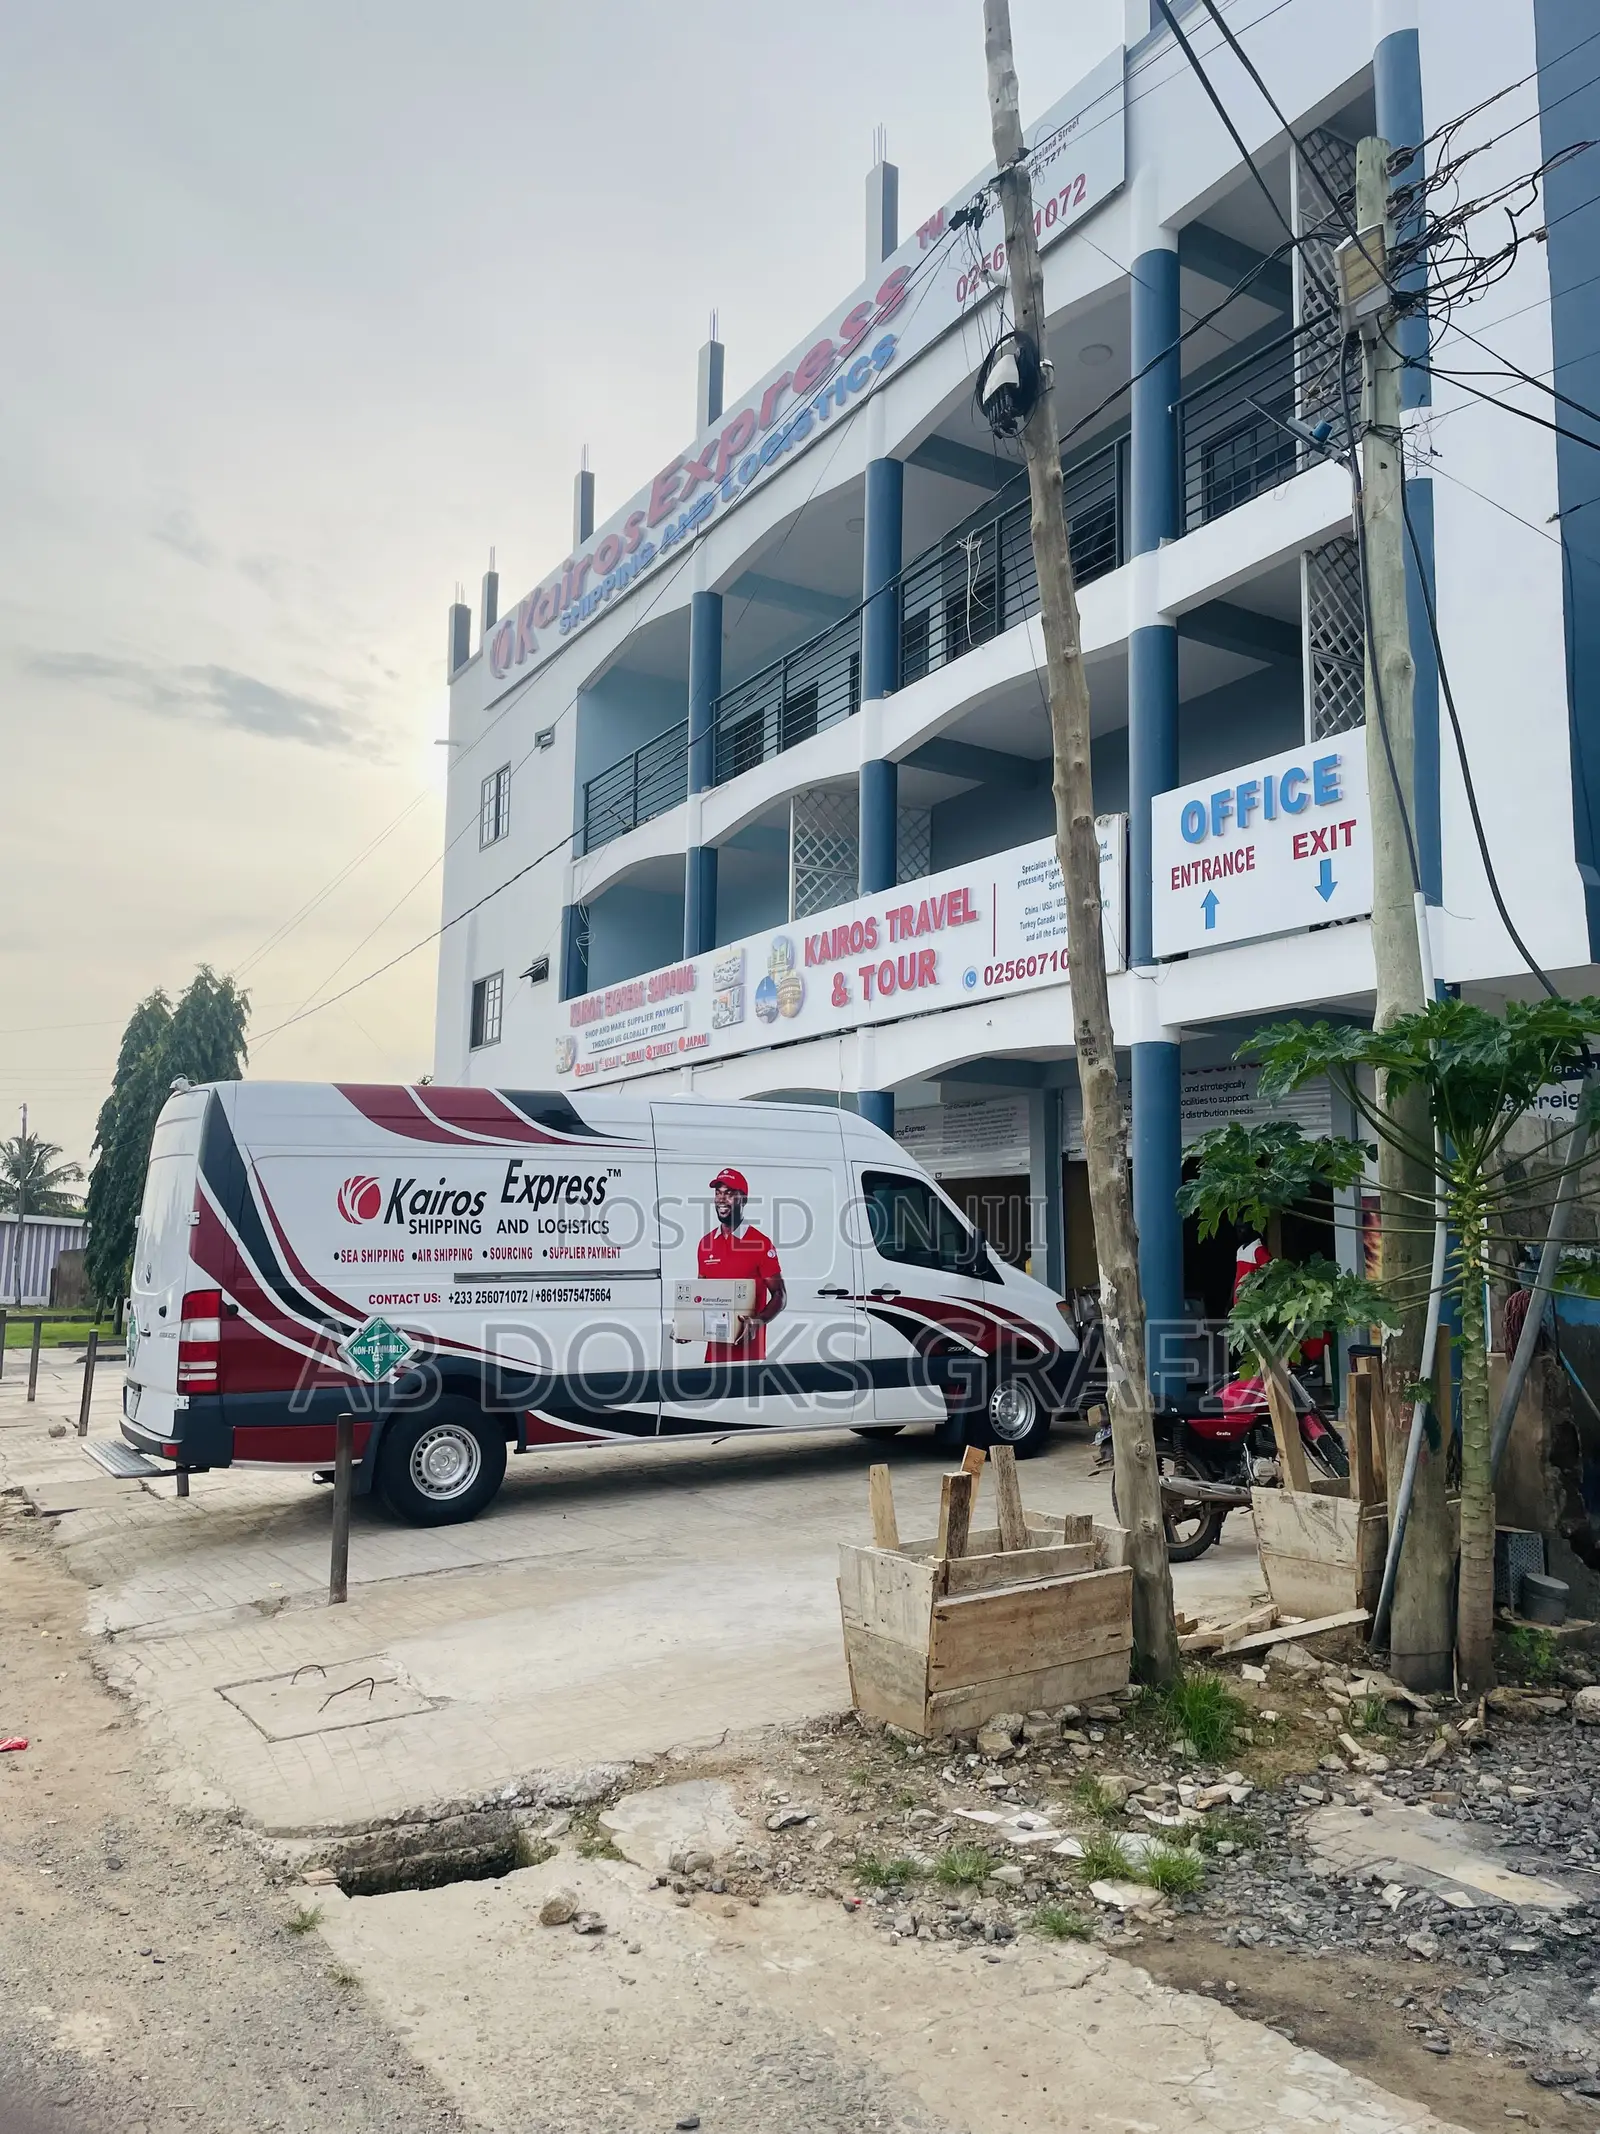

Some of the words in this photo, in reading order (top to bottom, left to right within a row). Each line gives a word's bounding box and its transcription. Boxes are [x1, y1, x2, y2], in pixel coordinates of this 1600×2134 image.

[1058, 117, 1080, 141] Street
[956, 173, 1086, 303] 02561072
[515, 510, 645, 665] Kairos
[647, 265, 911, 528] Express
[559, 541, 656, 636] SHIPPING
[660, 491, 717, 555] AND
[720, 333, 898, 503] LOGISTICS
[1180, 753, 1343, 845] OFFICE
[1022, 860, 1047, 875] Specialize
[1048, 857, 1054, 866] in
[1170, 845, 1255, 891] ENTRANCE
[1293, 819, 1358, 861] EXIT
[1017, 873, 1045, 889] processing
[1045, 867, 1060, 880] Flight
[1048, 880, 1065, 891] Servic
[1025, 904, 1039, 915] China
[805, 917, 879, 967] KAIROS
[886, 887, 978, 943] TRAVEL
[1020, 919, 1036, 930] Turkey
[1037, 915, 1055, 926] Canada
[1026, 934, 1035, 942] and
[1043, 929, 1051, 938] the
[1052, 926, 1067, 936] Europ
[831, 971, 849, 1008] &
[859, 948, 938, 1001] TOUR
[984, 948, 1069, 986] 02560710
[648, 964, 696, 1003] SHIPPING
[585, 1028, 599, 1039] SHOP
[599, 1025, 610, 1035] AND
[611, 1021, 626, 1033] MAKE
[627, 1012, 654, 1027] SUPPLIER
[655, 1004, 684, 1018] PAYMENT
[592, 1037, 614, 1049] THROUGH
[623, 1027, 649, 1041] GLOBALLY
[651, 1023, 666, 1033] FROM
[604, 1057, 617, 1068] USA
[653, 1041, 674, 1056] TURKEY
[685, 1034, 707, 1048] JAPAN
[1184, 1083, 1199, 1093] and
[1200, 1079, 1246, 1093] strategically
[1181, 1096, 1209, 1107] acilities
[1209, 1096, 1218, 1104] to
[1218, 1093, 1250, 1105] support
[1186, 1109, 1229, 1119] distribution
[383, 1177, 487, 1225] Kairos
[500, 1159, 608, 1212] Express
[607, 1168, 622, 1177] TM
[409, 1219, 482, 1235] SHIPPING
[497, 1219, 529, 1234] AND
[538, 1219, 610, 1235] LOGISTICS
[341, 1249, 359, 1263] SEA
[361, 1249, 405, 1263] SHIPPING
[417, 1249, 433, 1262] AIR
[434, 1248, 473, 1262] SHIPPING
[490, 1247, 533, 1260] SOURCING
[549, 1246, 586, 1260] SUPPLIER
[587, 1246, 622, 1259] PAYMENT
[368, 1293, 421, 1305] CONTACT
[423, 1292, 442, 1304] US:
[448, 1290, 473, 1305] +233
[475, 1289, 528, 1305] 256071072
[535, 1288, 612, 1303] +8619575475664
[353, 1344, 404, 1355] NON-FLAMMABLE
